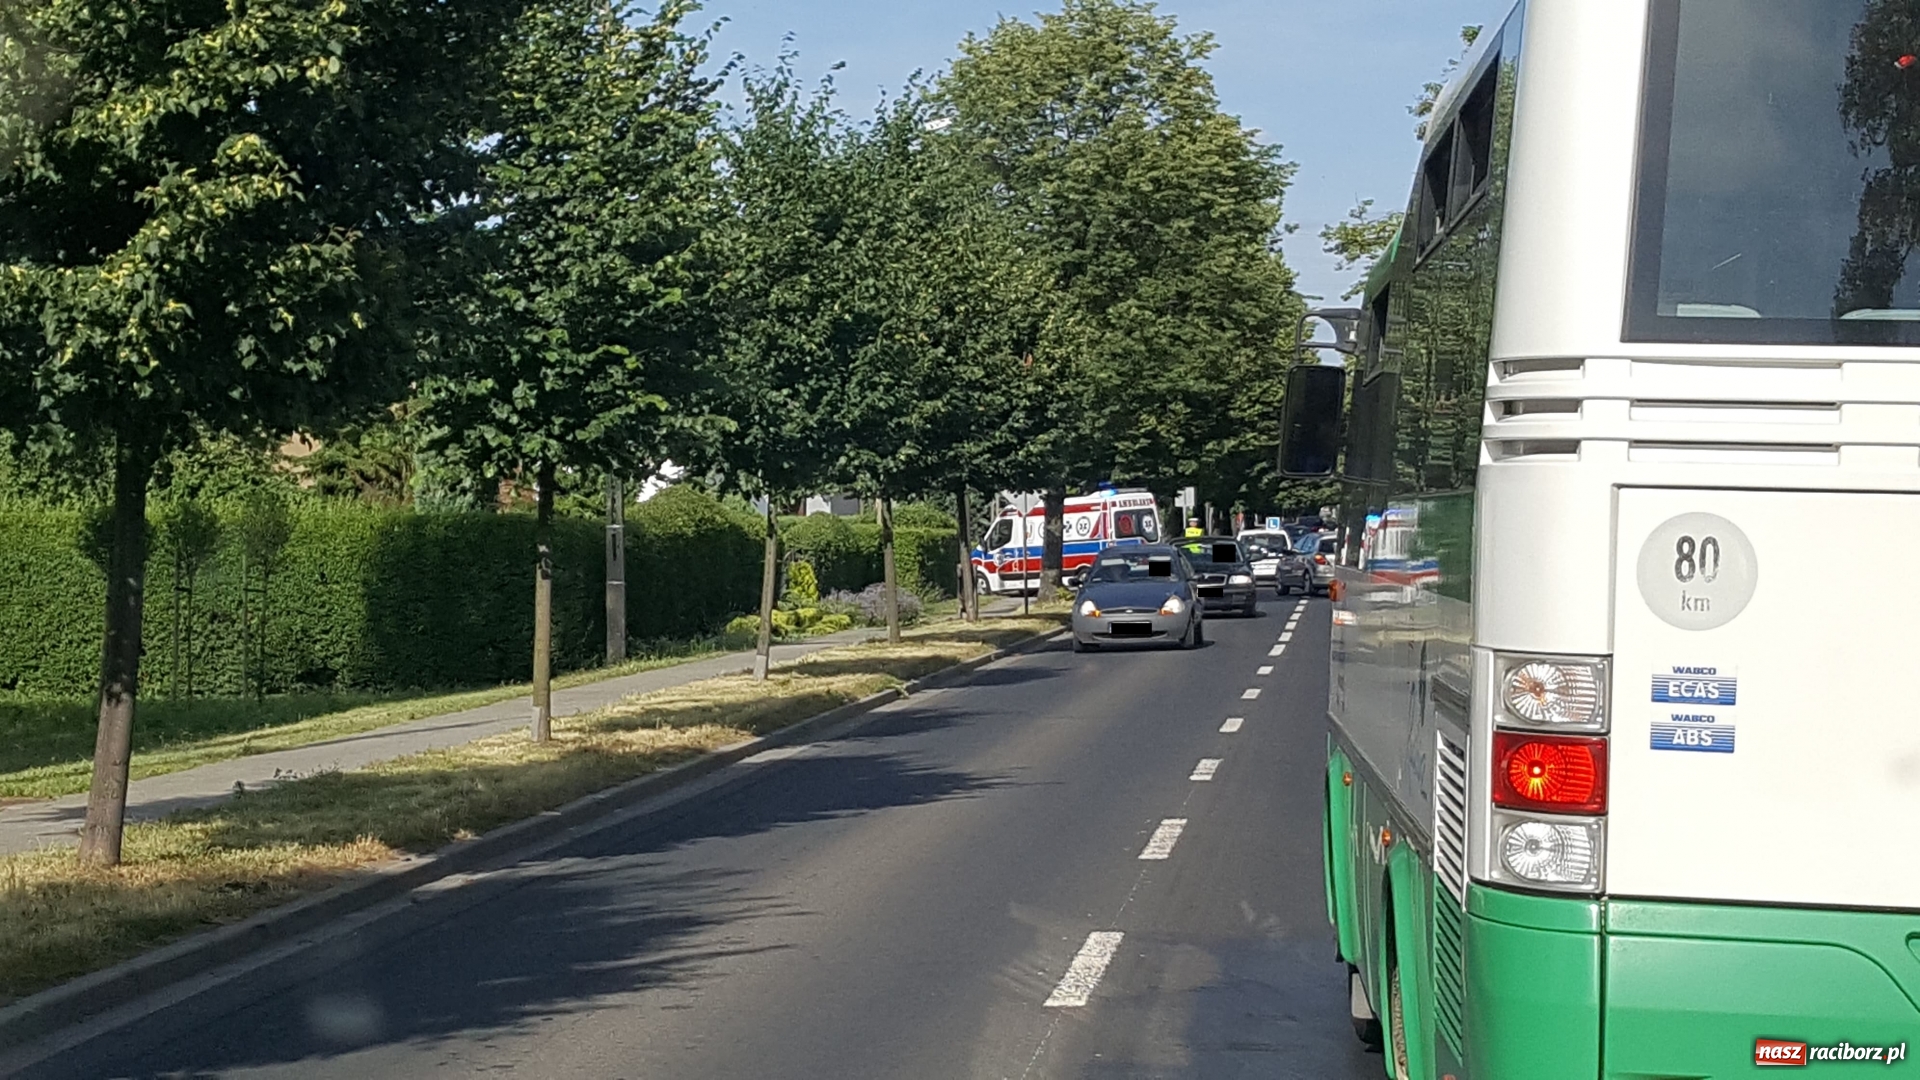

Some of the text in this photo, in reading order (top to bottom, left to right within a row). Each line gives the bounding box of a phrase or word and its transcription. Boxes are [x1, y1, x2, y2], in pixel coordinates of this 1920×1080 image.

[1674, 535, 1720, 583] 80
[1681, 590, 1711, 612] km
[1672, 665, 1717, 676] WABCO
[1668, 681, 1720, 699] ECAS
[1671, 713, 1715, 723] WABCO
[1672, 729, 1713, 746] ABS
